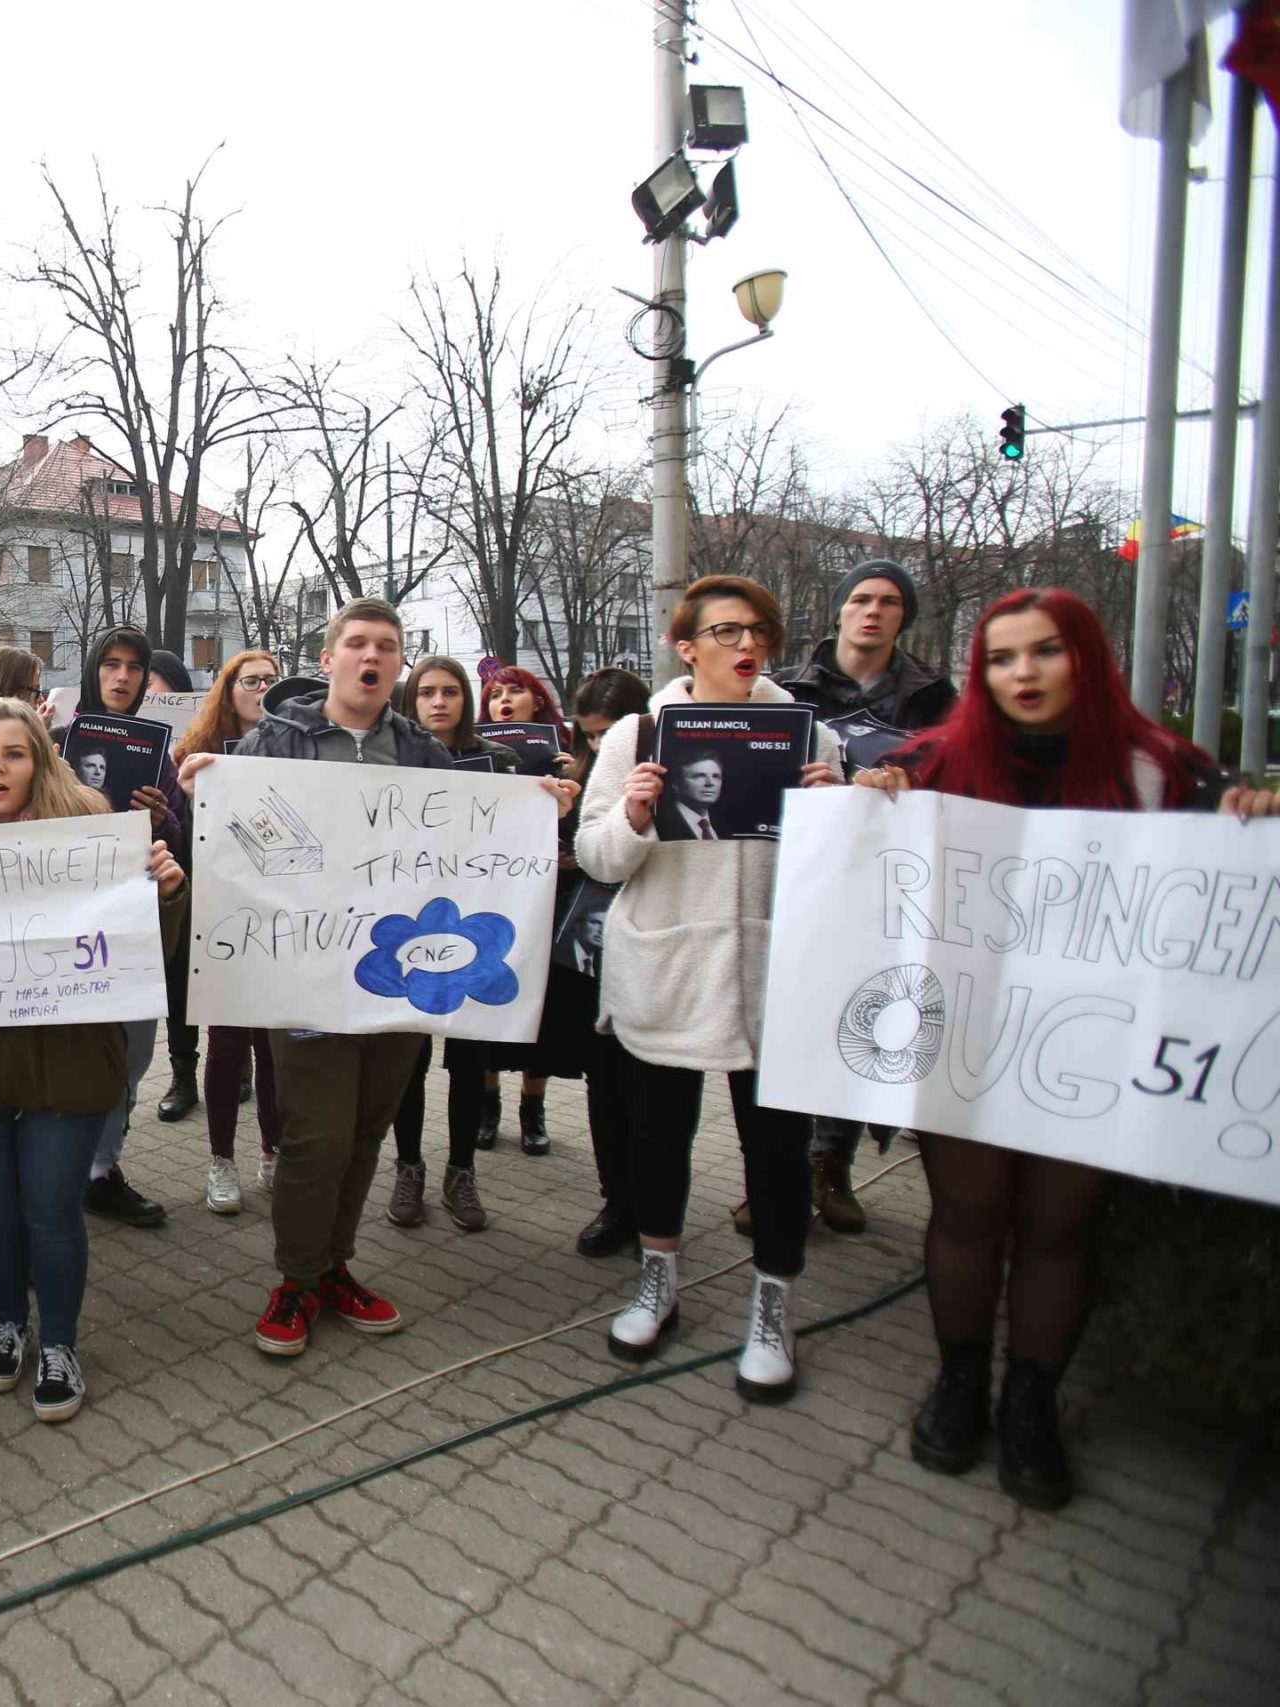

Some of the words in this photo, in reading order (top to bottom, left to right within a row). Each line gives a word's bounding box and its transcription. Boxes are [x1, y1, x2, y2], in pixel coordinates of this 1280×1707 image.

[80, 722, 104, 732] IULIAN
[104, 726, 129, 737] IANCU,
[677, 720, 711, 729] IULIAN
[714, 721, 751, 731] IANCU,
[126, 744, 142, 753] OUG
[750, 741, 773, 750] OUG
[774, 742, 791, 750] 51!
[353, 849, 559, 888] TRANSPORT
[73, 930, 109, 971] 51
[406, 944, 460, 964] CNE
[16, 986, 50, 1001] MASA
[838, 963, 1136, 1119] OUG
